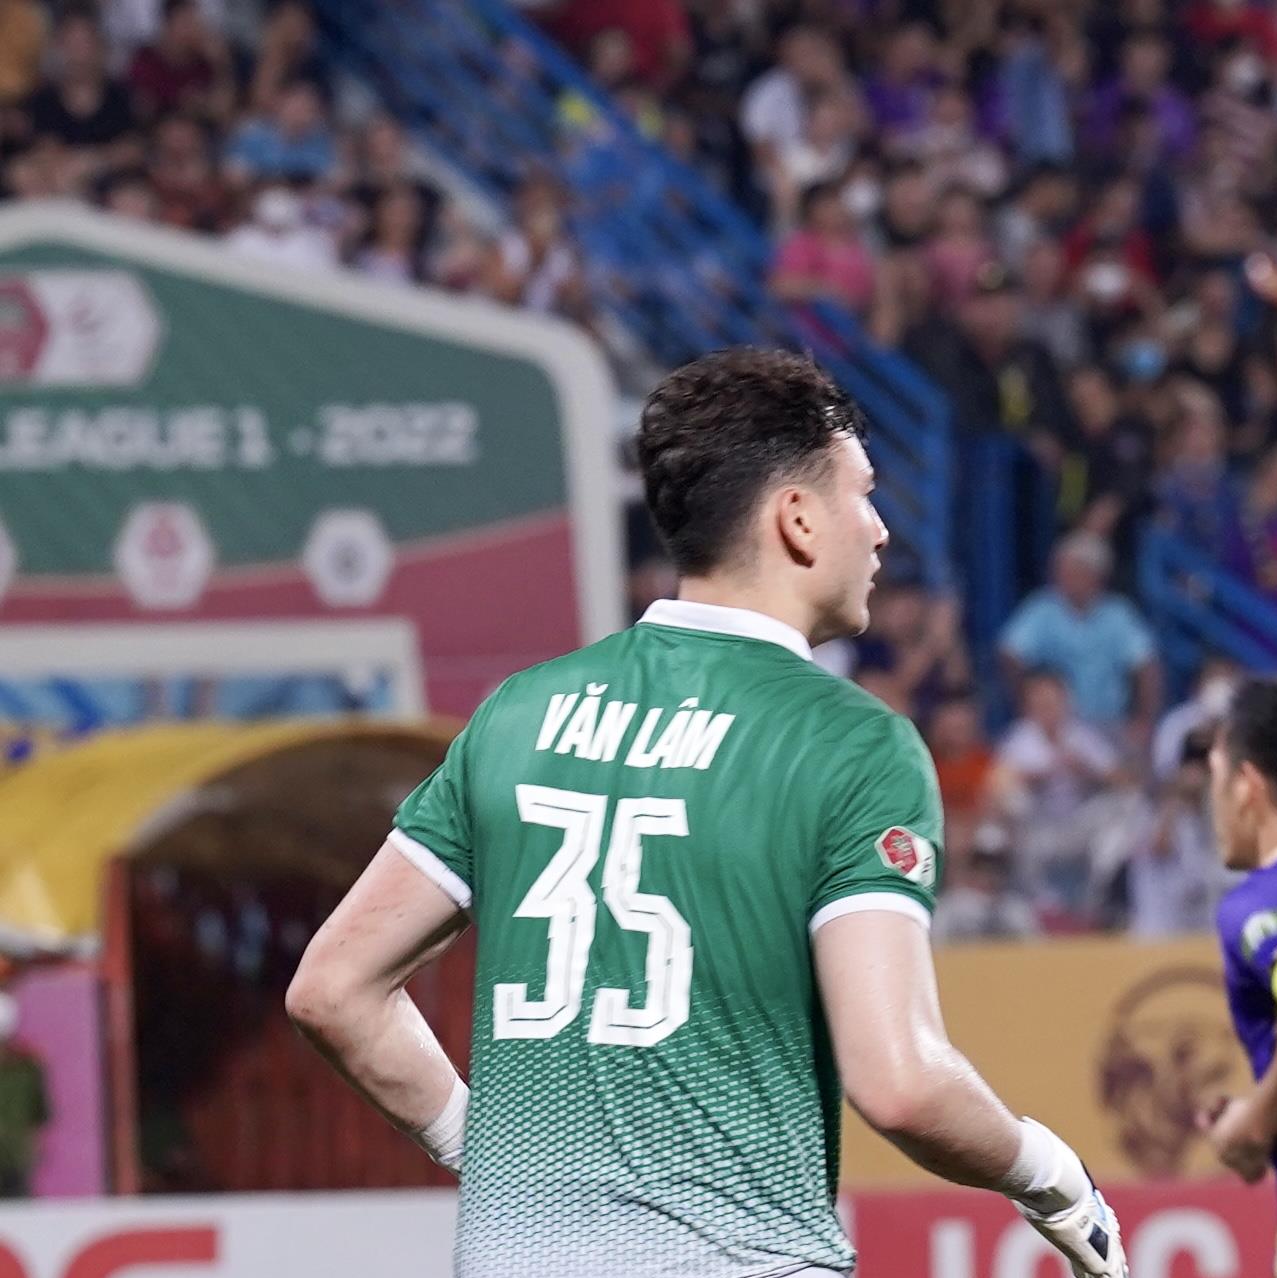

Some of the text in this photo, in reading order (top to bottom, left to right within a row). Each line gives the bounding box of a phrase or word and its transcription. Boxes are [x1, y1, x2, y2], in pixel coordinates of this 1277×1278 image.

[319, 401, 477, 465] 2022
[536, 682, 735, 770] VĂN LÂM
[493, 783, 695, 1048] 35
